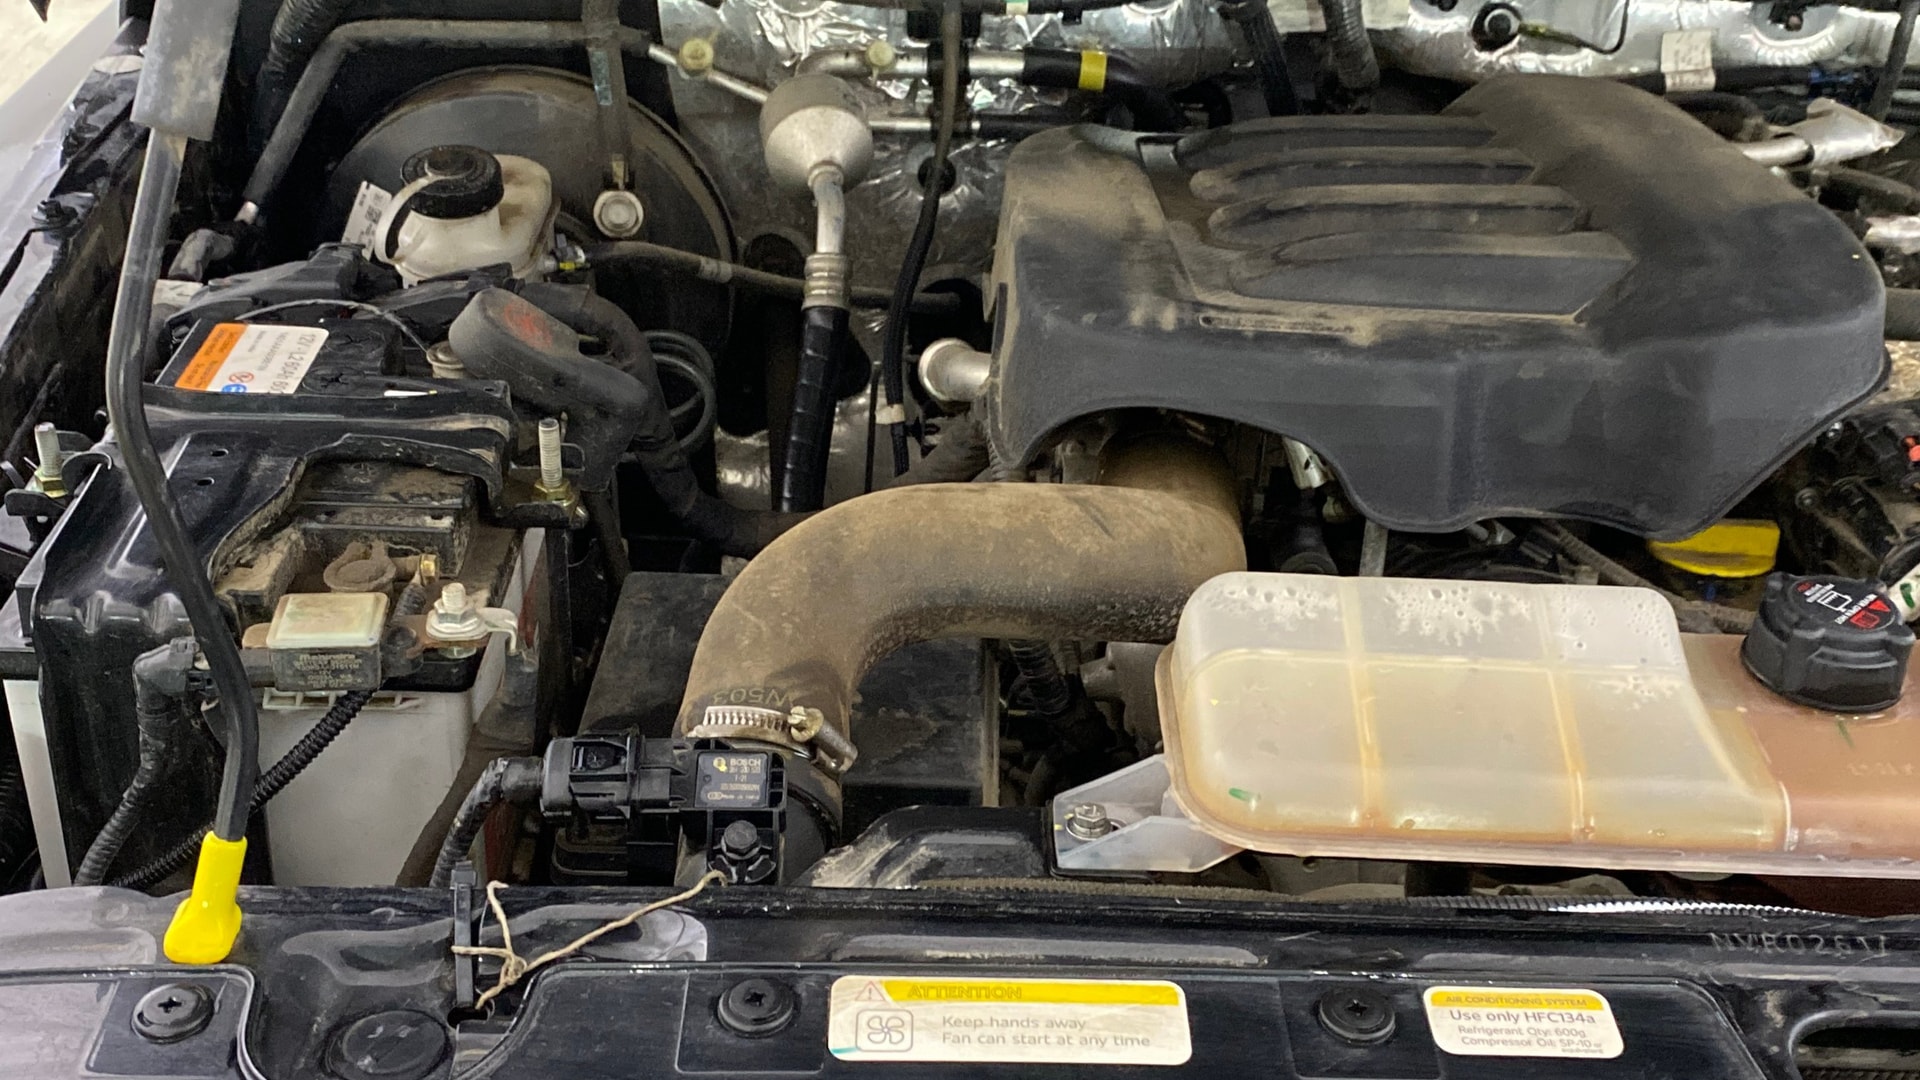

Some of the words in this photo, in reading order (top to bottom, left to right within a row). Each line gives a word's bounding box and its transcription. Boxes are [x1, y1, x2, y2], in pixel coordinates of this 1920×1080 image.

[730, 758, 761, 766] BOSCH
[907, 985, 1023, 999] ATTENTION
[1465, 996, 1543, 1005] CONDITIONING
[1545, 998, 1587, 1006] SYSTEM
[1450, 1009, 1481, 1021] Use
[1486, 1011, 1519, 1024] only
[1524, 1012, 1596, 1023] HFC134a
[942, 1015, 984, 1030] Keep
[989, 1016, 1039, 1029] hands
[1045, 1019, 1087, 1032] away
[1458, 1025, 1524, 1036] Refrigerant
[1527, 1027, 1552, 1037] Qty:
[1555, 1028, 1586, 1038] 600g
[942, 1033, 971, 1045] Fan
[977, 1035, 1006, 1046] can
[1012, 1034, 1050, 1046] start
[1057, 1036, 1073, 1046] at
[1079, 1036, 1108, 1049] any
[1113, 1034, 1151, 1047] time
[1461, 1036, 1532, 1047] Compressor
[1559, 1039, 1592, 1048] SP-10
